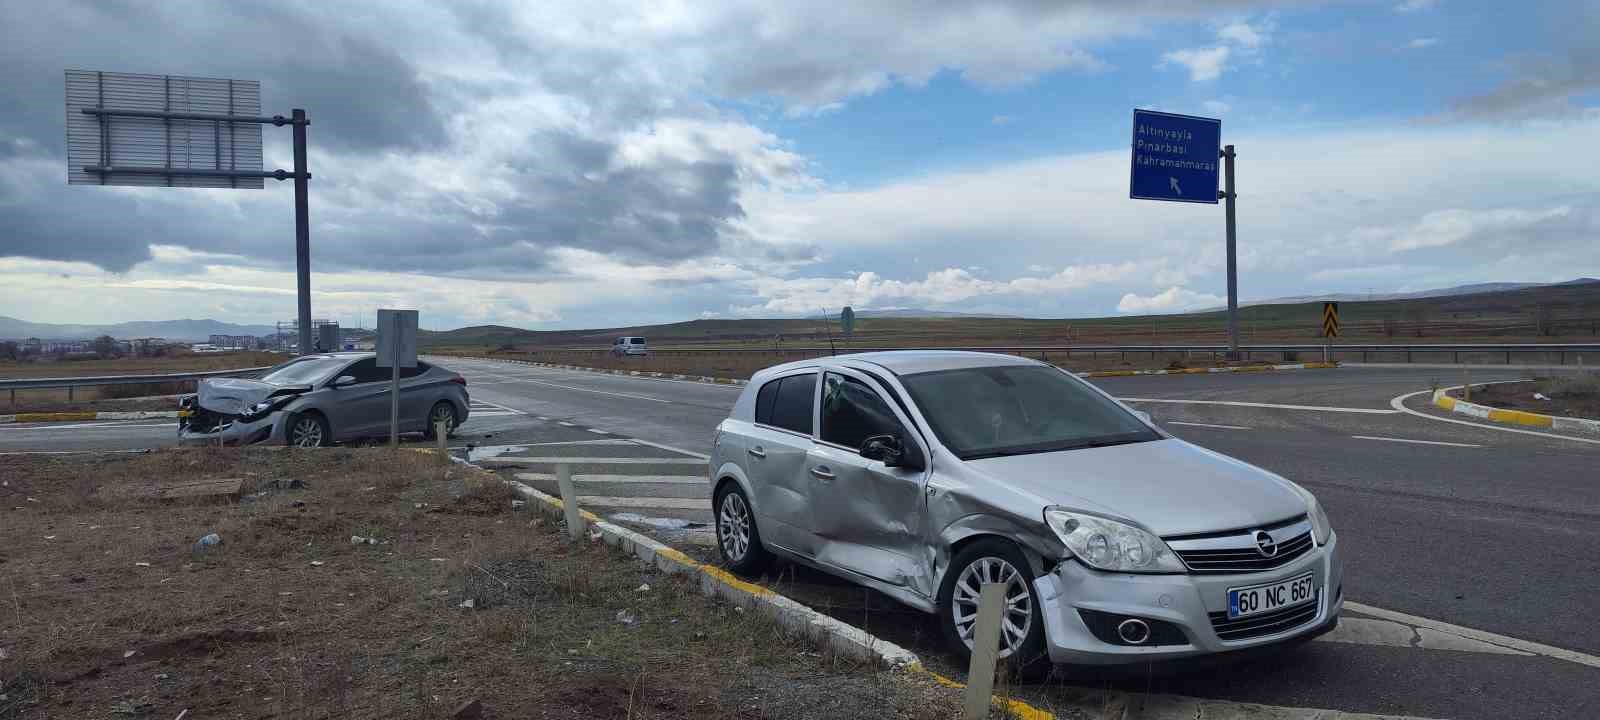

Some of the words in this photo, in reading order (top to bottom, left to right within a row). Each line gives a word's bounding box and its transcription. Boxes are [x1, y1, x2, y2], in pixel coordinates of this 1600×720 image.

[1239, 591, 1258, 612] 60
[1266, 586, 1286, 608] NC
[1291, 577, 1312, 601] 667
